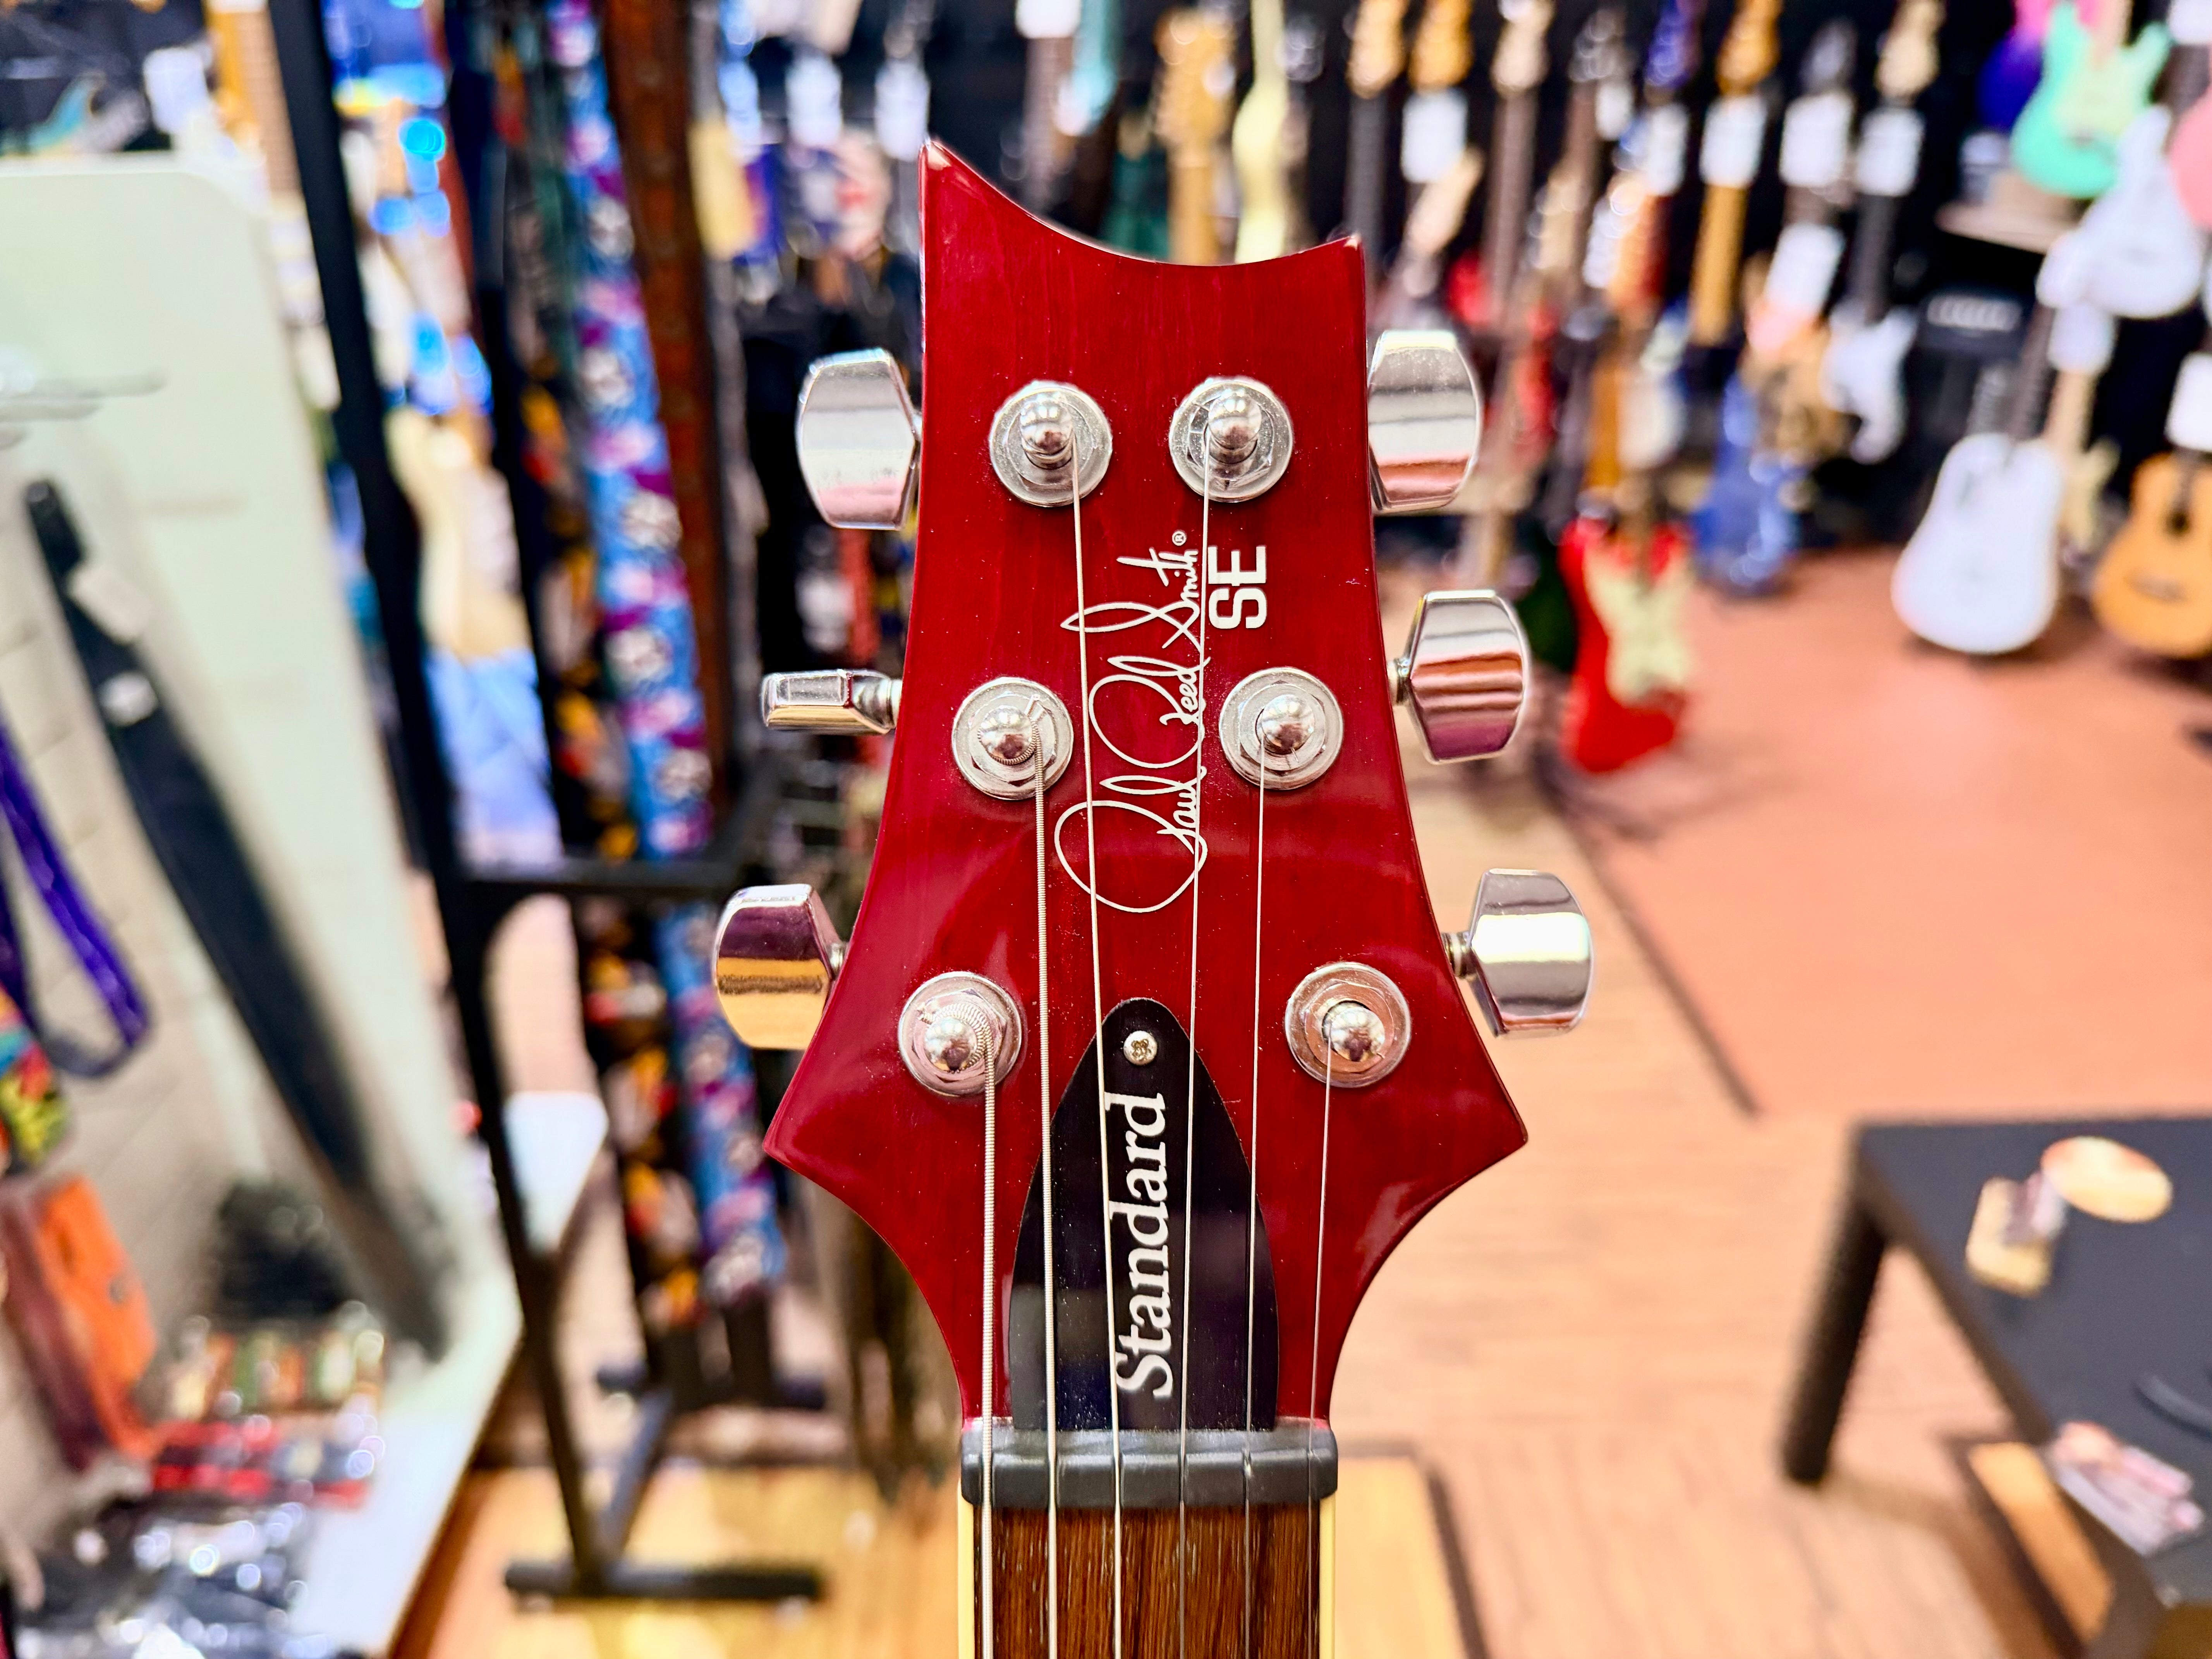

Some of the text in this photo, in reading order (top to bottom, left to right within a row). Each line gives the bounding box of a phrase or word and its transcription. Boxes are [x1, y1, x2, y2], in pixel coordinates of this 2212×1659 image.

[1208, 545, 1266, 629] SE
[1089, 655, 1211, 769] Reed
[1054, 766, 1207, 913] Paul
[1104, 1091, 1173, 1399] Standard
